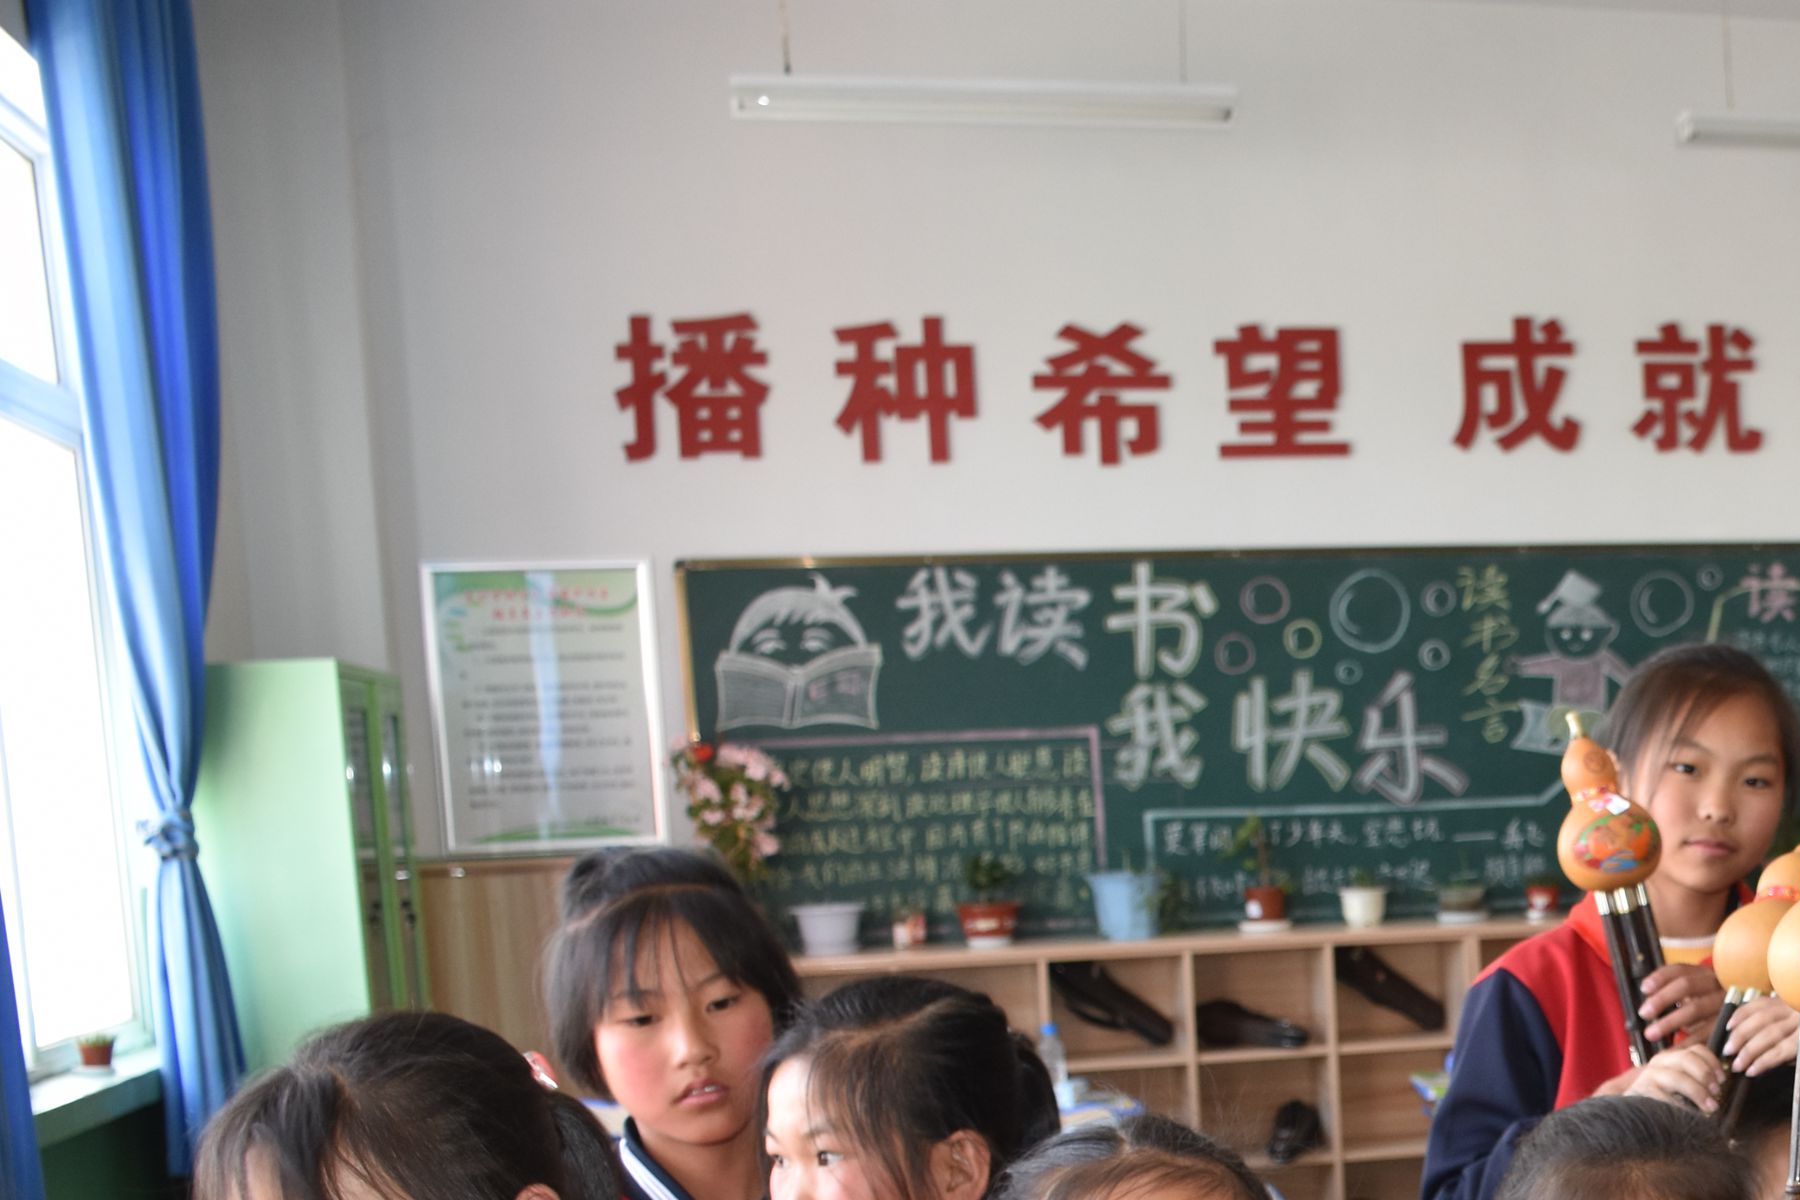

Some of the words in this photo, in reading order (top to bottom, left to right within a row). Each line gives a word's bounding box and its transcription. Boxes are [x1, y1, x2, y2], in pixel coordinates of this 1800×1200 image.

[614, 312, 1354, 467] 播种希望
[896, 561, 1218, 679] 我读书
[1107, 668, 1470, 805] 我快乐
